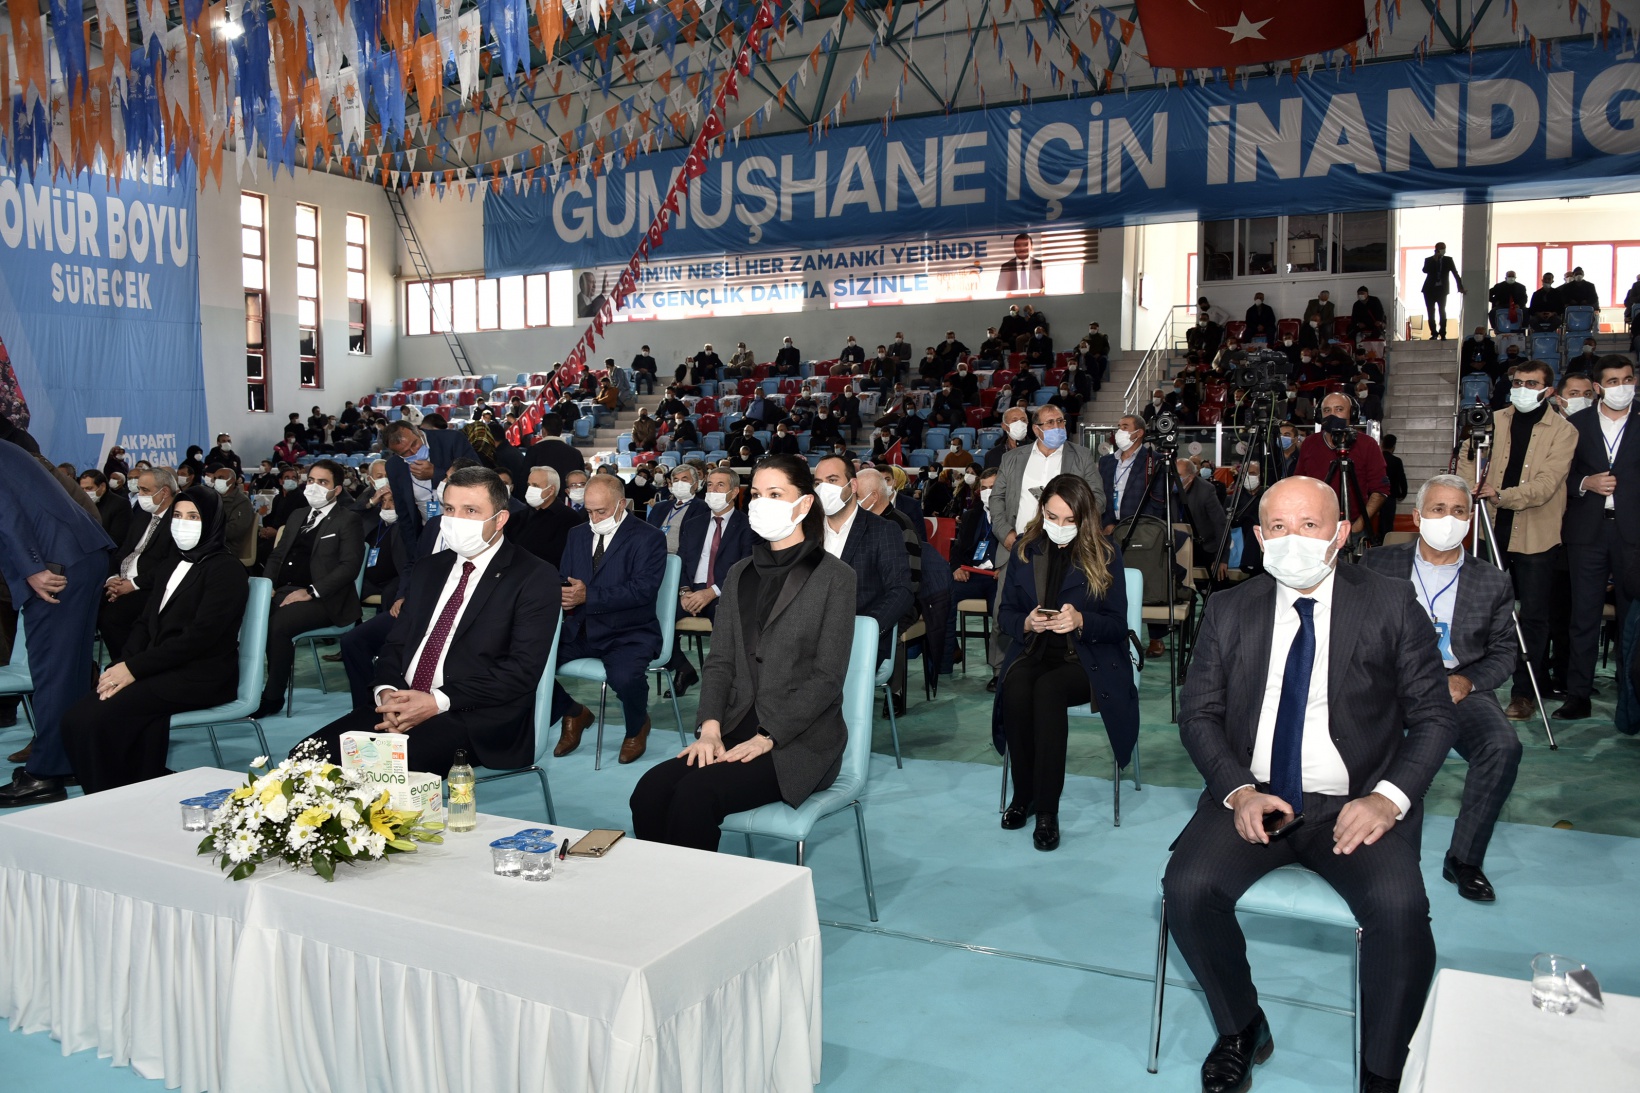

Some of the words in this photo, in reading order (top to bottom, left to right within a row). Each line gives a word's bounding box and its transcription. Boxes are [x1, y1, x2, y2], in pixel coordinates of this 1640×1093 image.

[552, 131, 988, 244] GÜMÜŞHANE
[1005, 101, 1168, 220] İÇİN
[0, 165, 101, 257] ÖMÜR
[106, 196, 189, 268] BOYU
[688, 257, 740, 280] NESLİ
[745, 257, 784, 276] HER
[790, 245, 885, 272] ZAMANKİ
[891, 240, 988, 264] YERİNDE
[51, 262, 153, 310] SÜRECEK
[619, 292, 646, 311] AK
[652, 284, 744, 308] GENÇLİK
[752, 279, 827, 302] DAİMA
[833, 271, 929, 297] SİZİNLE
[121, 434, 138, 450] AK
[140, 433, 176, 449] PARTİ
